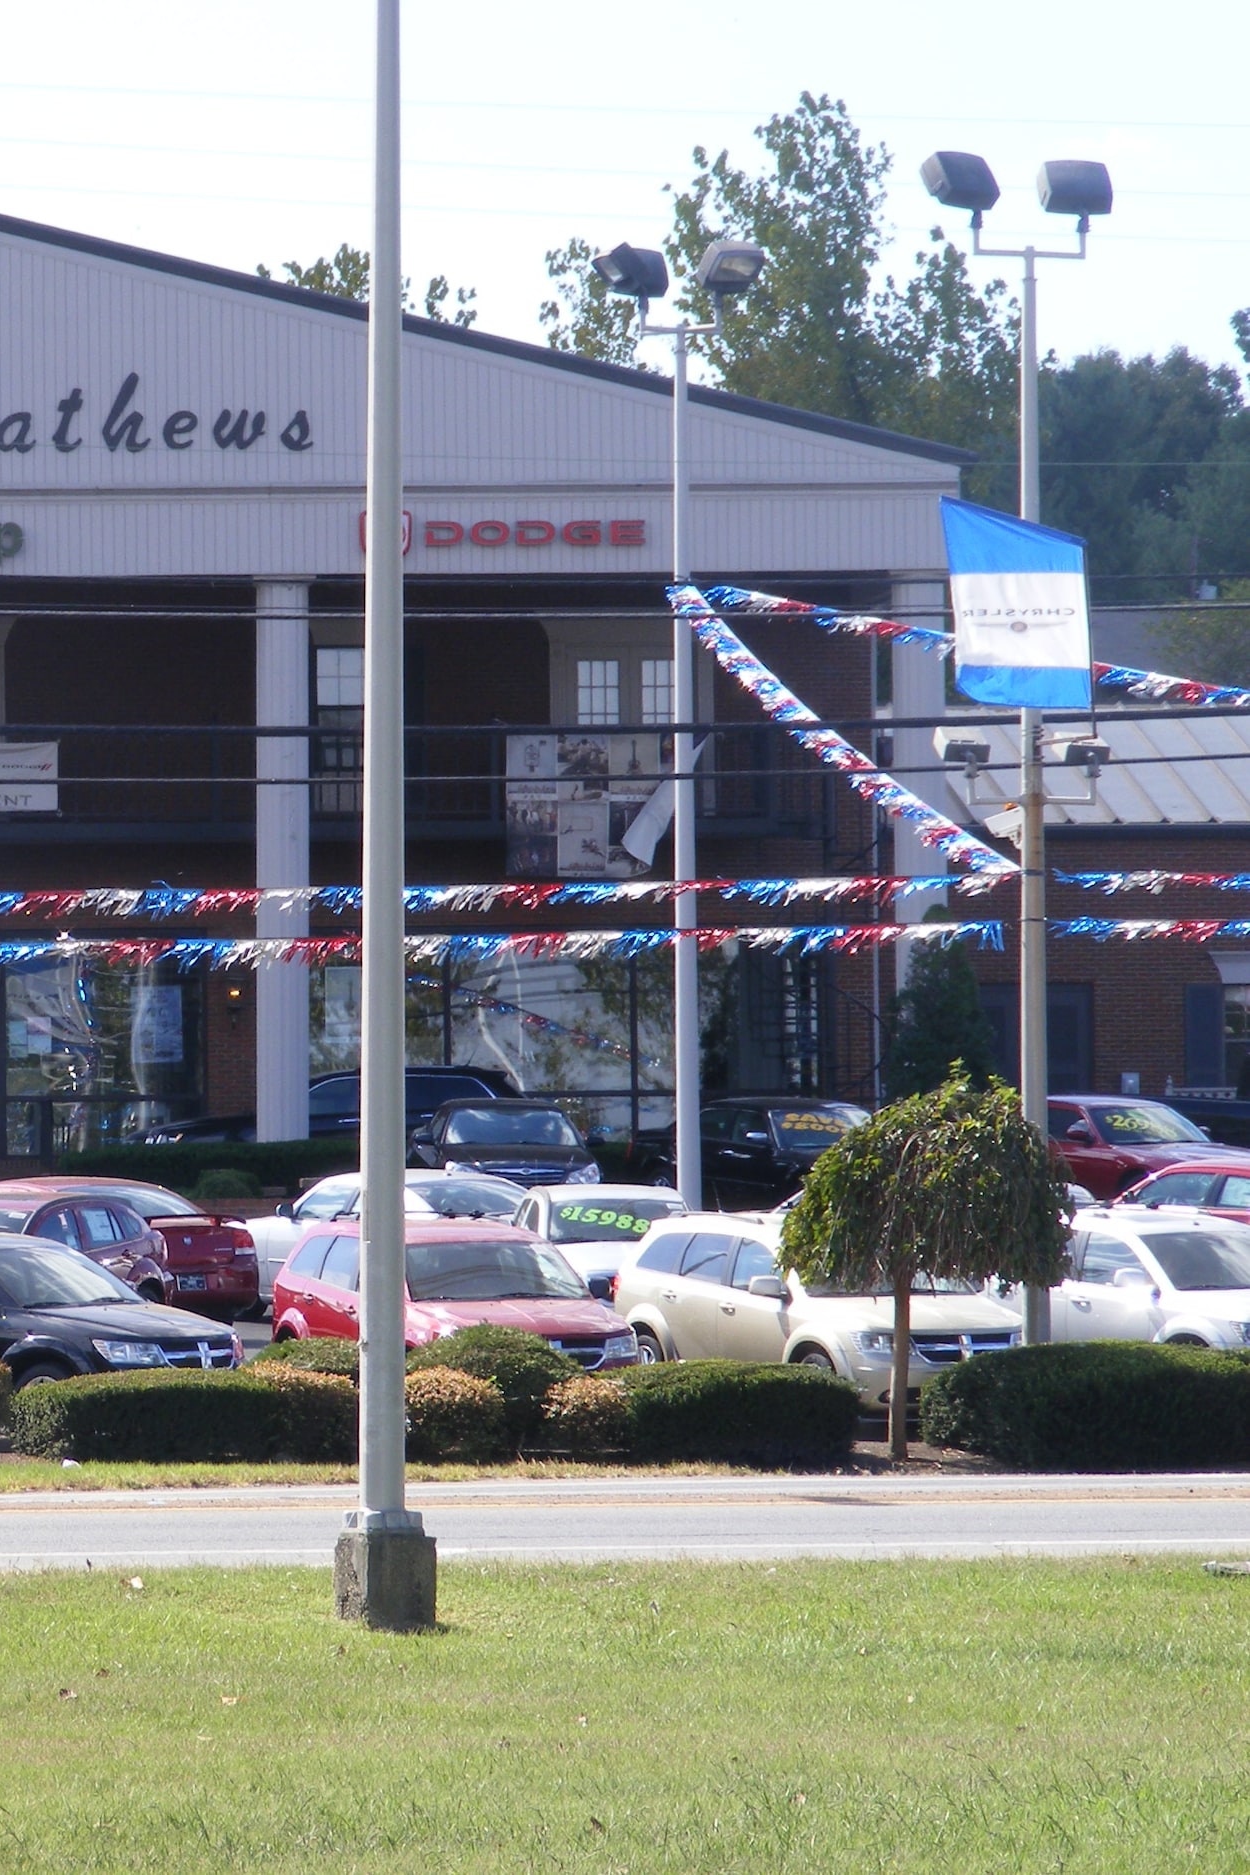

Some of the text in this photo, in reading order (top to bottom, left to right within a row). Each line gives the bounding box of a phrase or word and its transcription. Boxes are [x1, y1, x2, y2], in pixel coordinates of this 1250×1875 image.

[425, 520, 646, 547] DODGE
[784, 1112, 847, 1128] SAVE
[1104, 1114, 1178, 1139] $269
[560, 1206, 650, 1234] $15988
